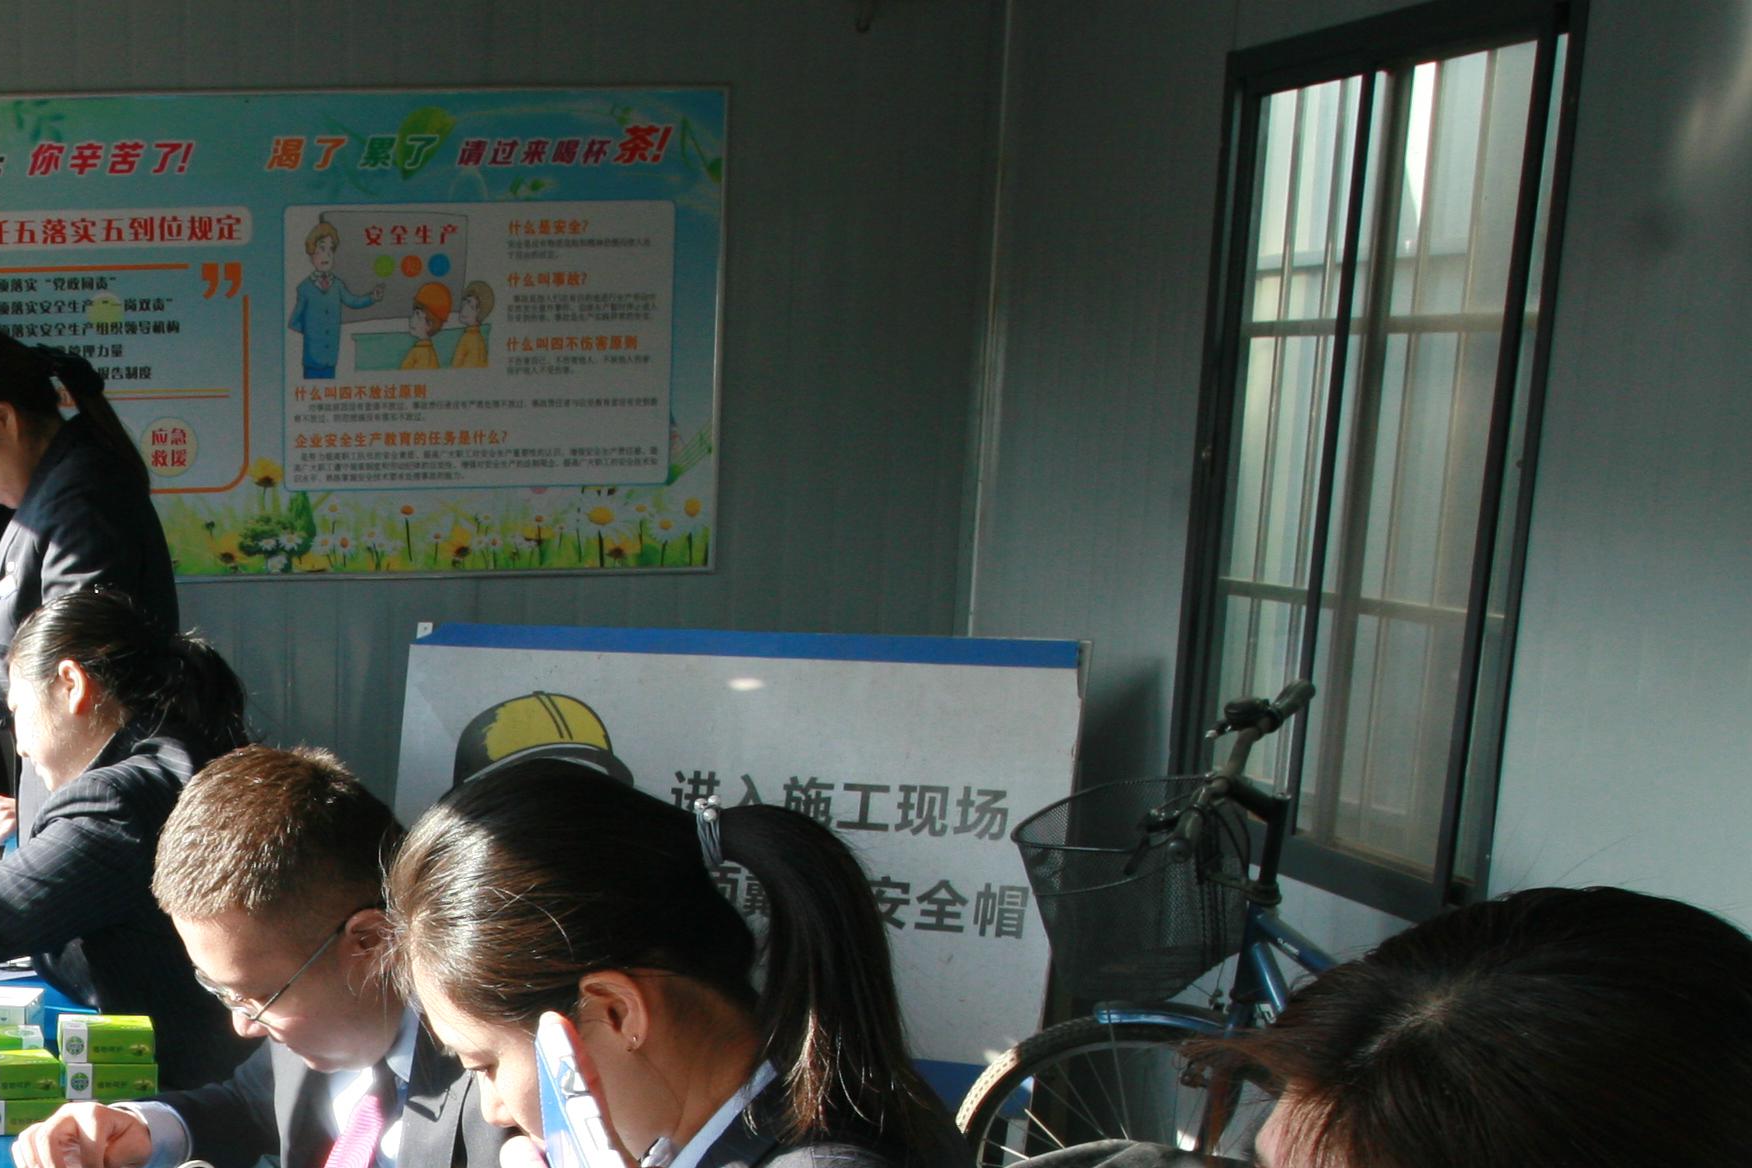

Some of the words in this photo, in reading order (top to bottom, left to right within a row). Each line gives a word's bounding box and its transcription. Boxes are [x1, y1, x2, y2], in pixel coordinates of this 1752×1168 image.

[28, 141, 195, 176] 你辛苦了!
[267, 135, 348, 170] 渴了
[359, 134, 441, 169] 累了
[456, 125, 673, 167] 请过来喝杯茶!
[363, 223, 460, 247] 安全生产
[151, 428, 187, 446] 应急
[151, 449, 187, 468] 救援
